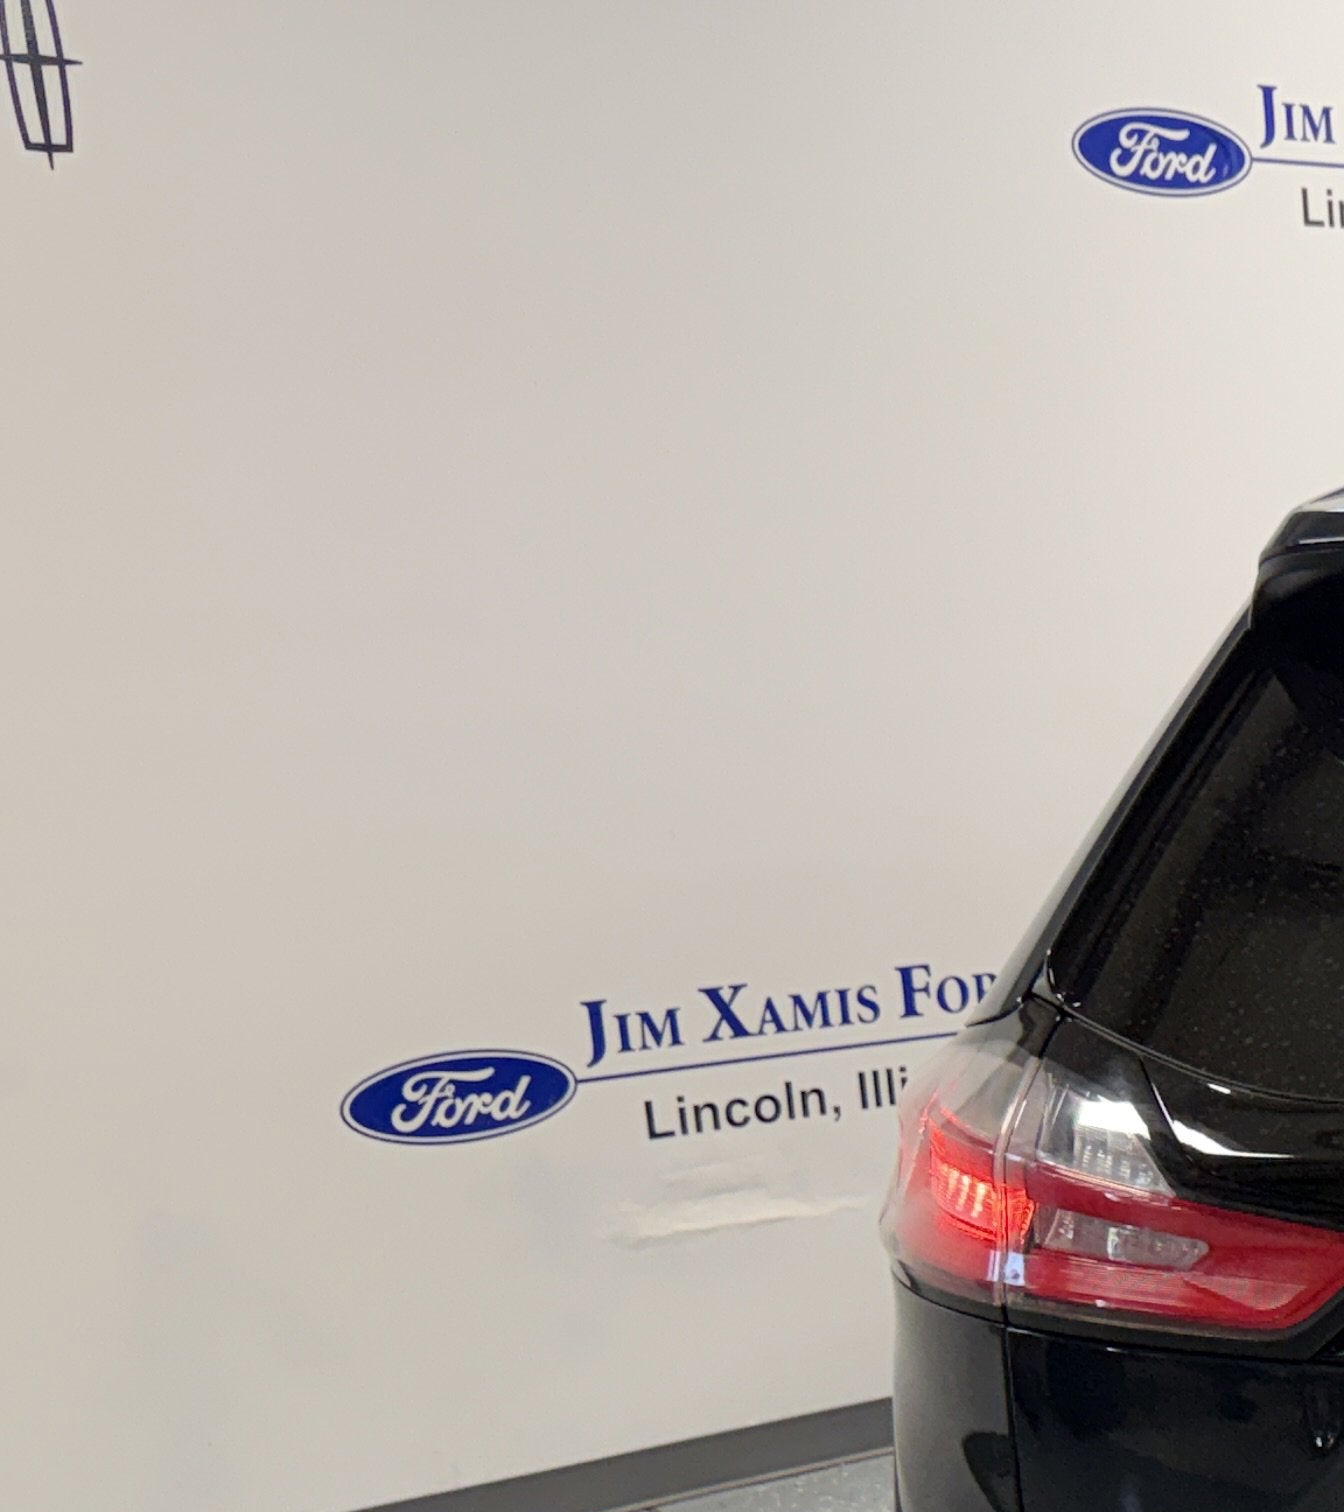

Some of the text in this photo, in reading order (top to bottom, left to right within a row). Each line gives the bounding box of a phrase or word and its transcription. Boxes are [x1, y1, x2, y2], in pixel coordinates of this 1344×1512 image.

[1257, 84, 1335, 149] JIM
[1109, 119, 1217, 184] Ford
[579, 963, 997, 1069] JIM XAMIS FO
[391, 1066, 532, 1133] Ford
[643, 1079, 842, 1141] Lincoln,
